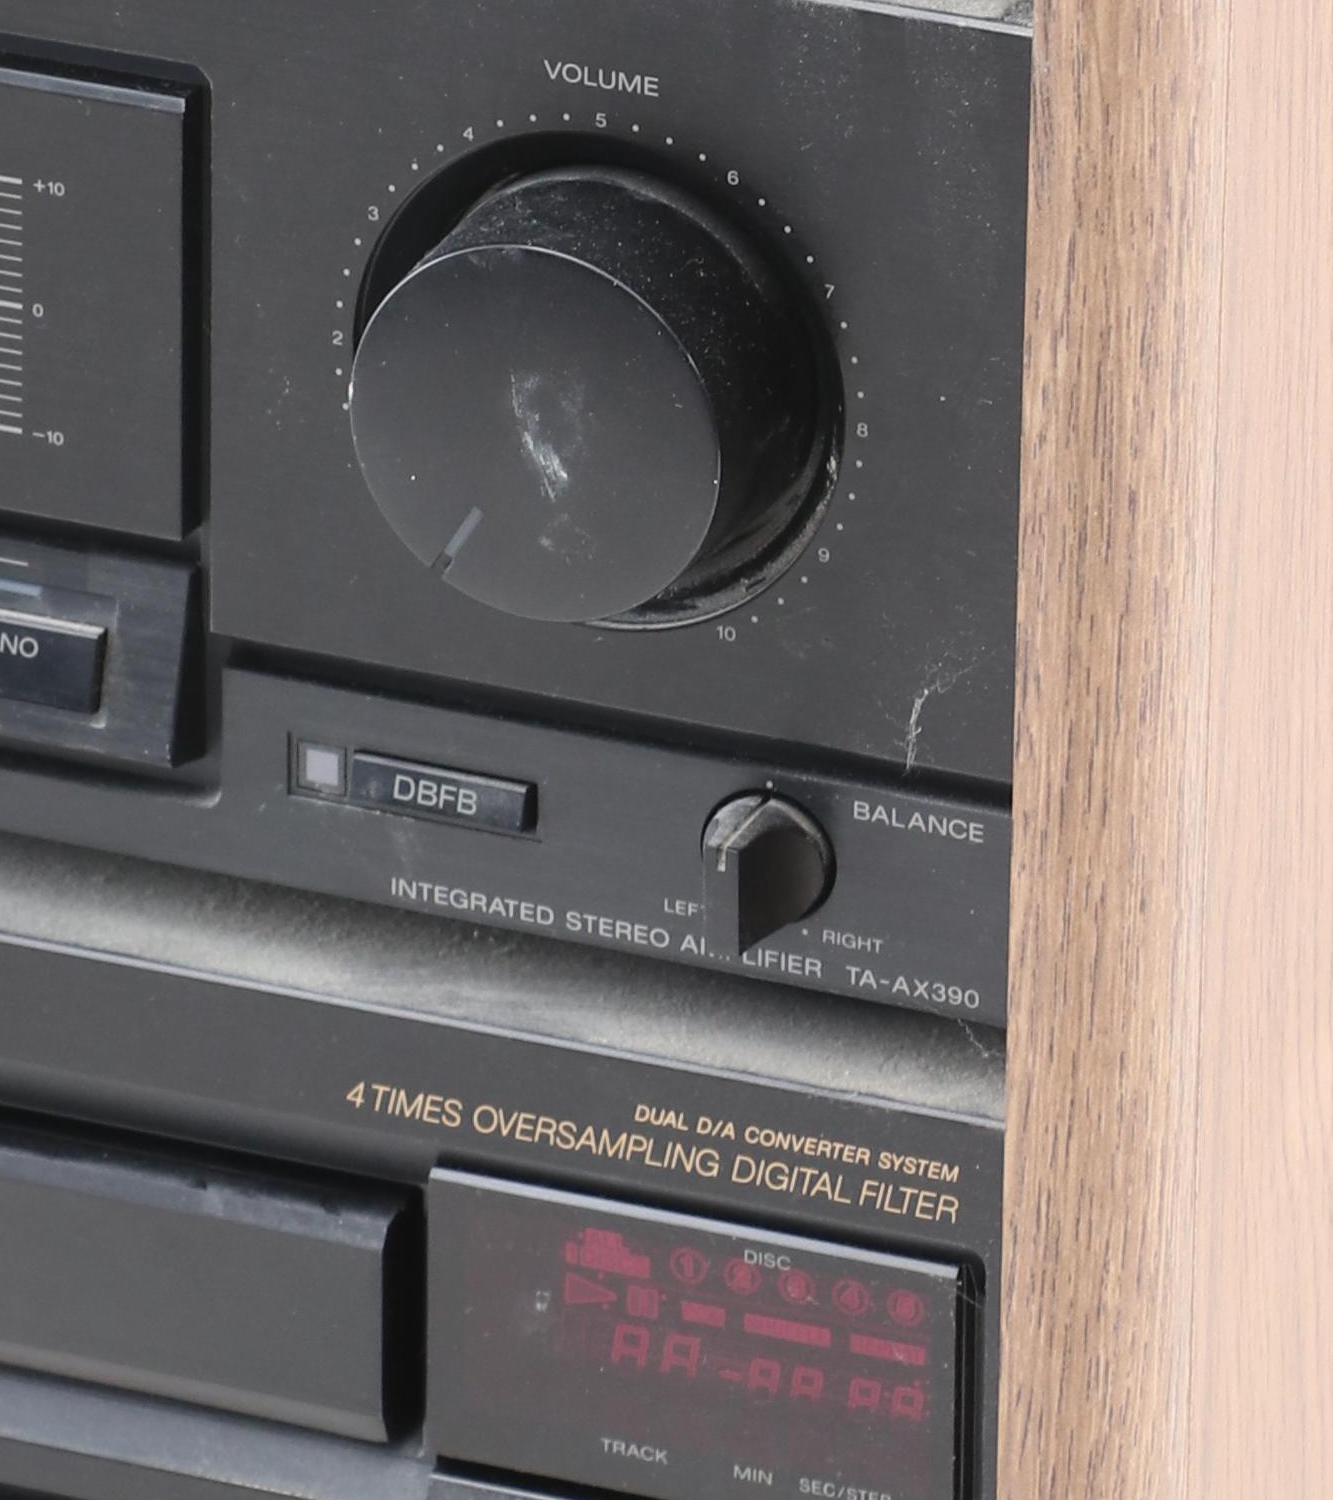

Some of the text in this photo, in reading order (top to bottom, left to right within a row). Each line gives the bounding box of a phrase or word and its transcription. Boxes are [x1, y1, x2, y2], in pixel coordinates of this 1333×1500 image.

[544, 59, 660, 97] VOLUME
[34, 179, 66, 197] +10
[393, 774, 478, 815] DBFB
[853, 800, 984, 843] BALANCE
[664, 897, 705, 917] LEF
[391, 877, 554, 925] INTEGRATED
[566, 911, 669, 949] STEREO
[845, 965, 980, 1009] TA-AX390
[822, 930, 884, 954] RIGHT
[634, 1105, 960, 1184] DUAL D/A CONVERTER SYSTEM
[472, 1106, 721, 1178] OVERSAMPLING
[732, 1154, 851, 1205] DIGITAL
[859, 1180, 960, 1225] FILTER
[744, 1250, 791, 1271] DISC
[600, 1438, 668, 1465] TRACK
[734, 1464, 773, 1487] MIN
